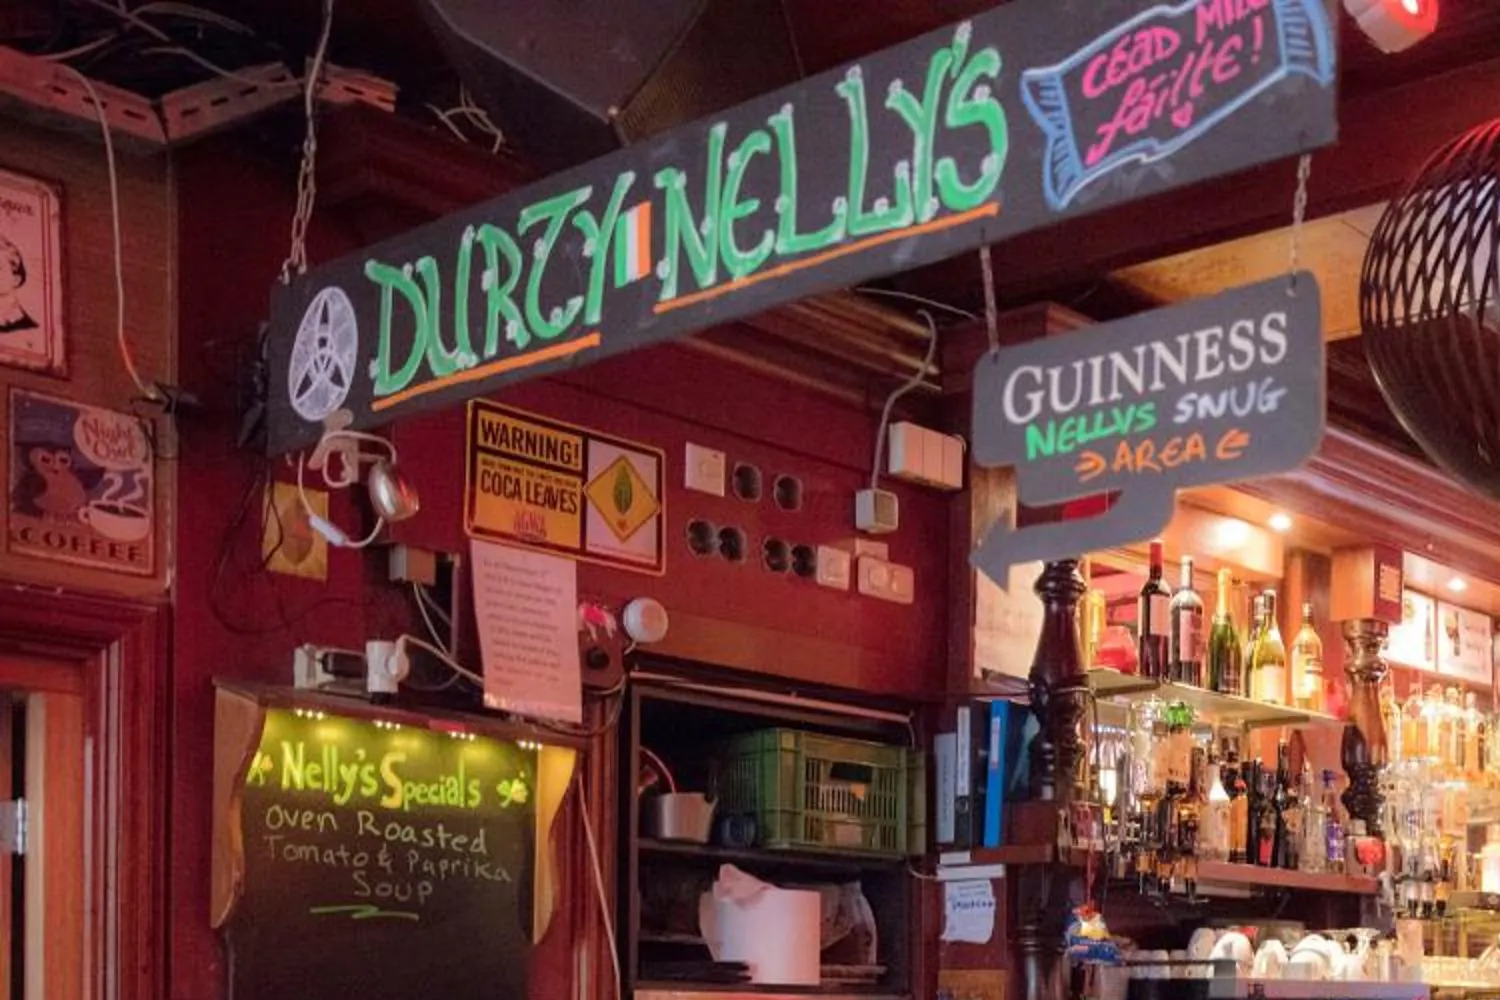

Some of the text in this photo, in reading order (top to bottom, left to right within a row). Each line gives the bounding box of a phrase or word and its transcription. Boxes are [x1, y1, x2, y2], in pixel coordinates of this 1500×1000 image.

[365, 20, 1009, 396] DURTY NELLY'S
[1003, 312, 1288, 424] GUINNESS
[1173, 377, 1287, 423] SNUG
[481, 417, 579, 466] WARNING!
[480, 469, 523, 501] COCA
[525, 478, 578, 515] LEAVES
[19, 527, 145, 562] COFFEE
[281, 741, 481, 811] Nelly's Specials
[357, 810, 488, 855] Roasted
[263, 834, 512, 882] Tomato & Paprika
